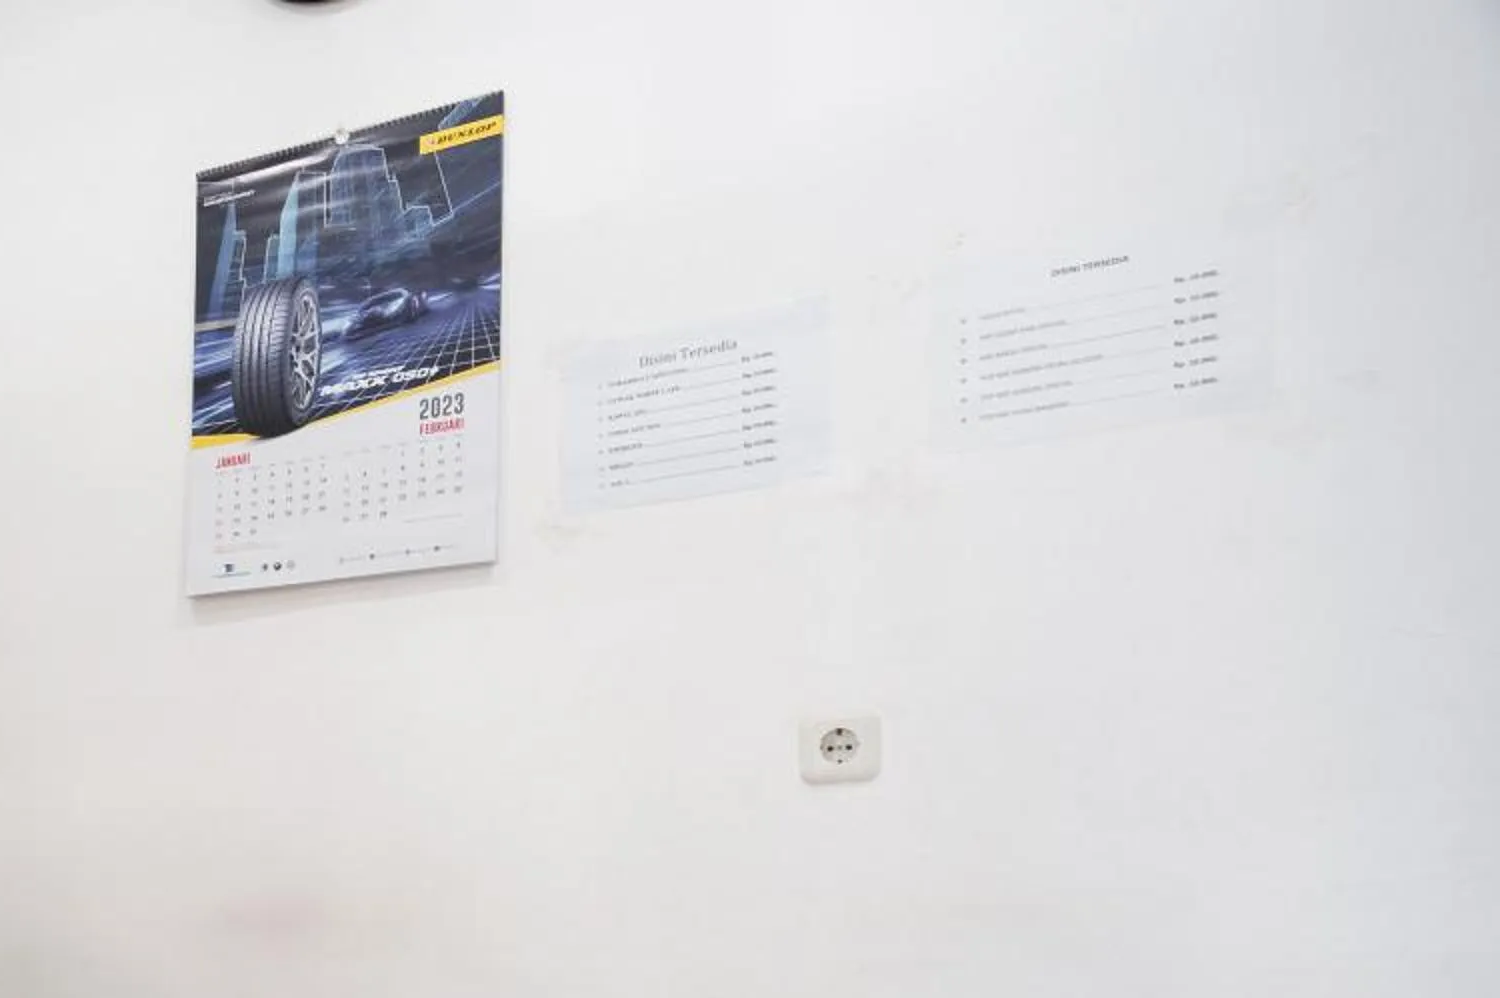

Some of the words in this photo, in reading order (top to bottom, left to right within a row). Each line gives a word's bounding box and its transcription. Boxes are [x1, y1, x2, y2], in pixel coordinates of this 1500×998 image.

[419, 391, 466, 420] 2023
[419, 417, 465, 435] FEBRUARI
[215, 451, 251, 469] JANUARI
